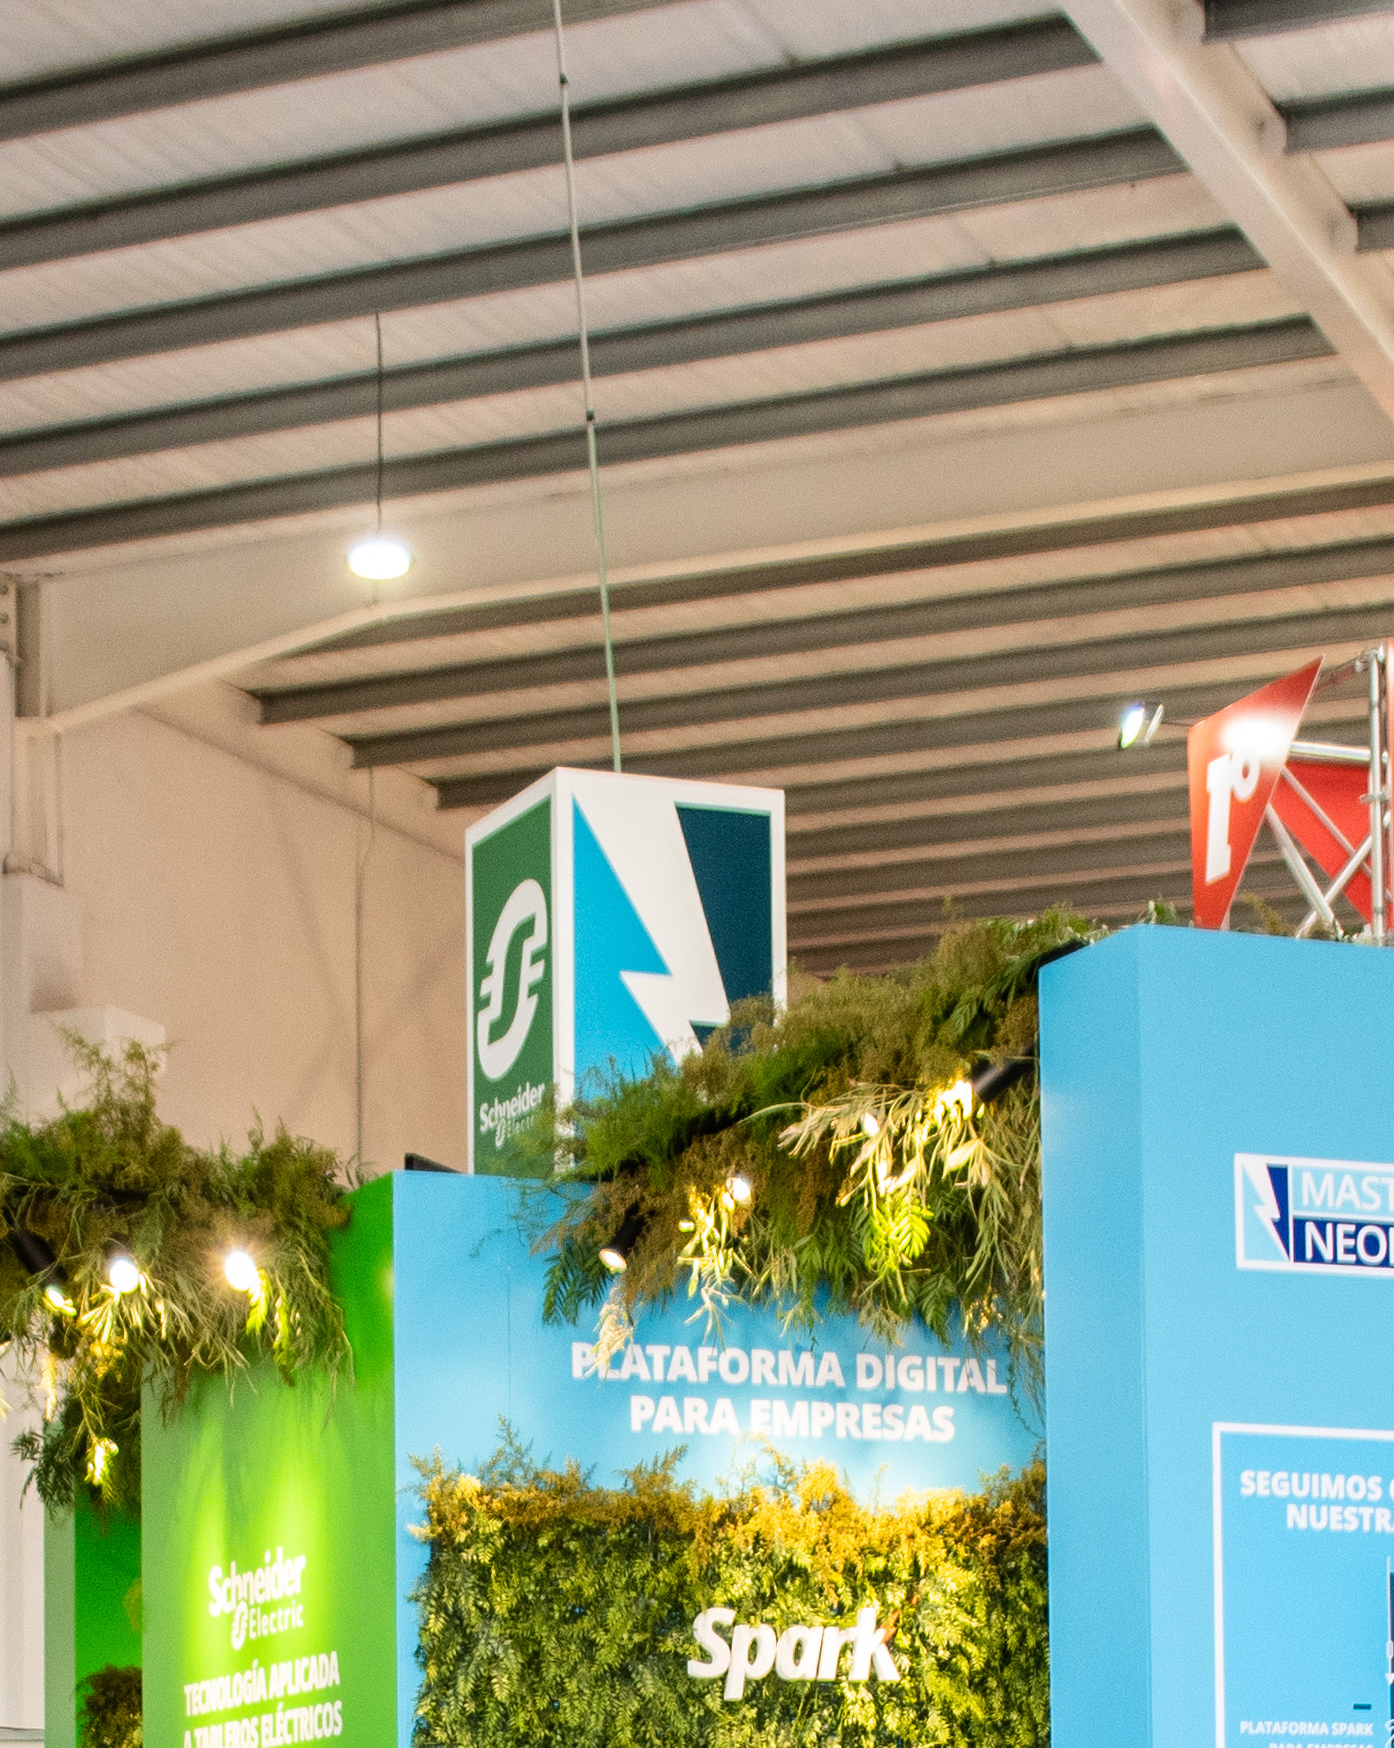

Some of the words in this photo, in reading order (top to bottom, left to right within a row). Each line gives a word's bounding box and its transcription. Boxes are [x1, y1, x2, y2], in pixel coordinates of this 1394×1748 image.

[480, 1081, 546, 1134] Schneider
[857, 1354, 1007, 1394] DIGITAL
[630, 1395, 739, 1434] PARA
[749, 1400, 956, 1443] EMPRESAS
[1240, 1469, 1383, 1501] SEGUIMOS
[209, 1547, 306, 1617] Schneider
[249, 1600, 304, 1639] Electric
[687, 1606, 901, 1700] Spark
[184, 1659, 267, 1717] TECNOLOGÍA
[269, 1651, 340, 1699] APLICADA
[261, 1700, 343, 1748] ELÉCTRICOS
[1240, 1721, 1329, 1736] PLATAFORMA
[1332, 1722, 1373, 1736] SPARK
